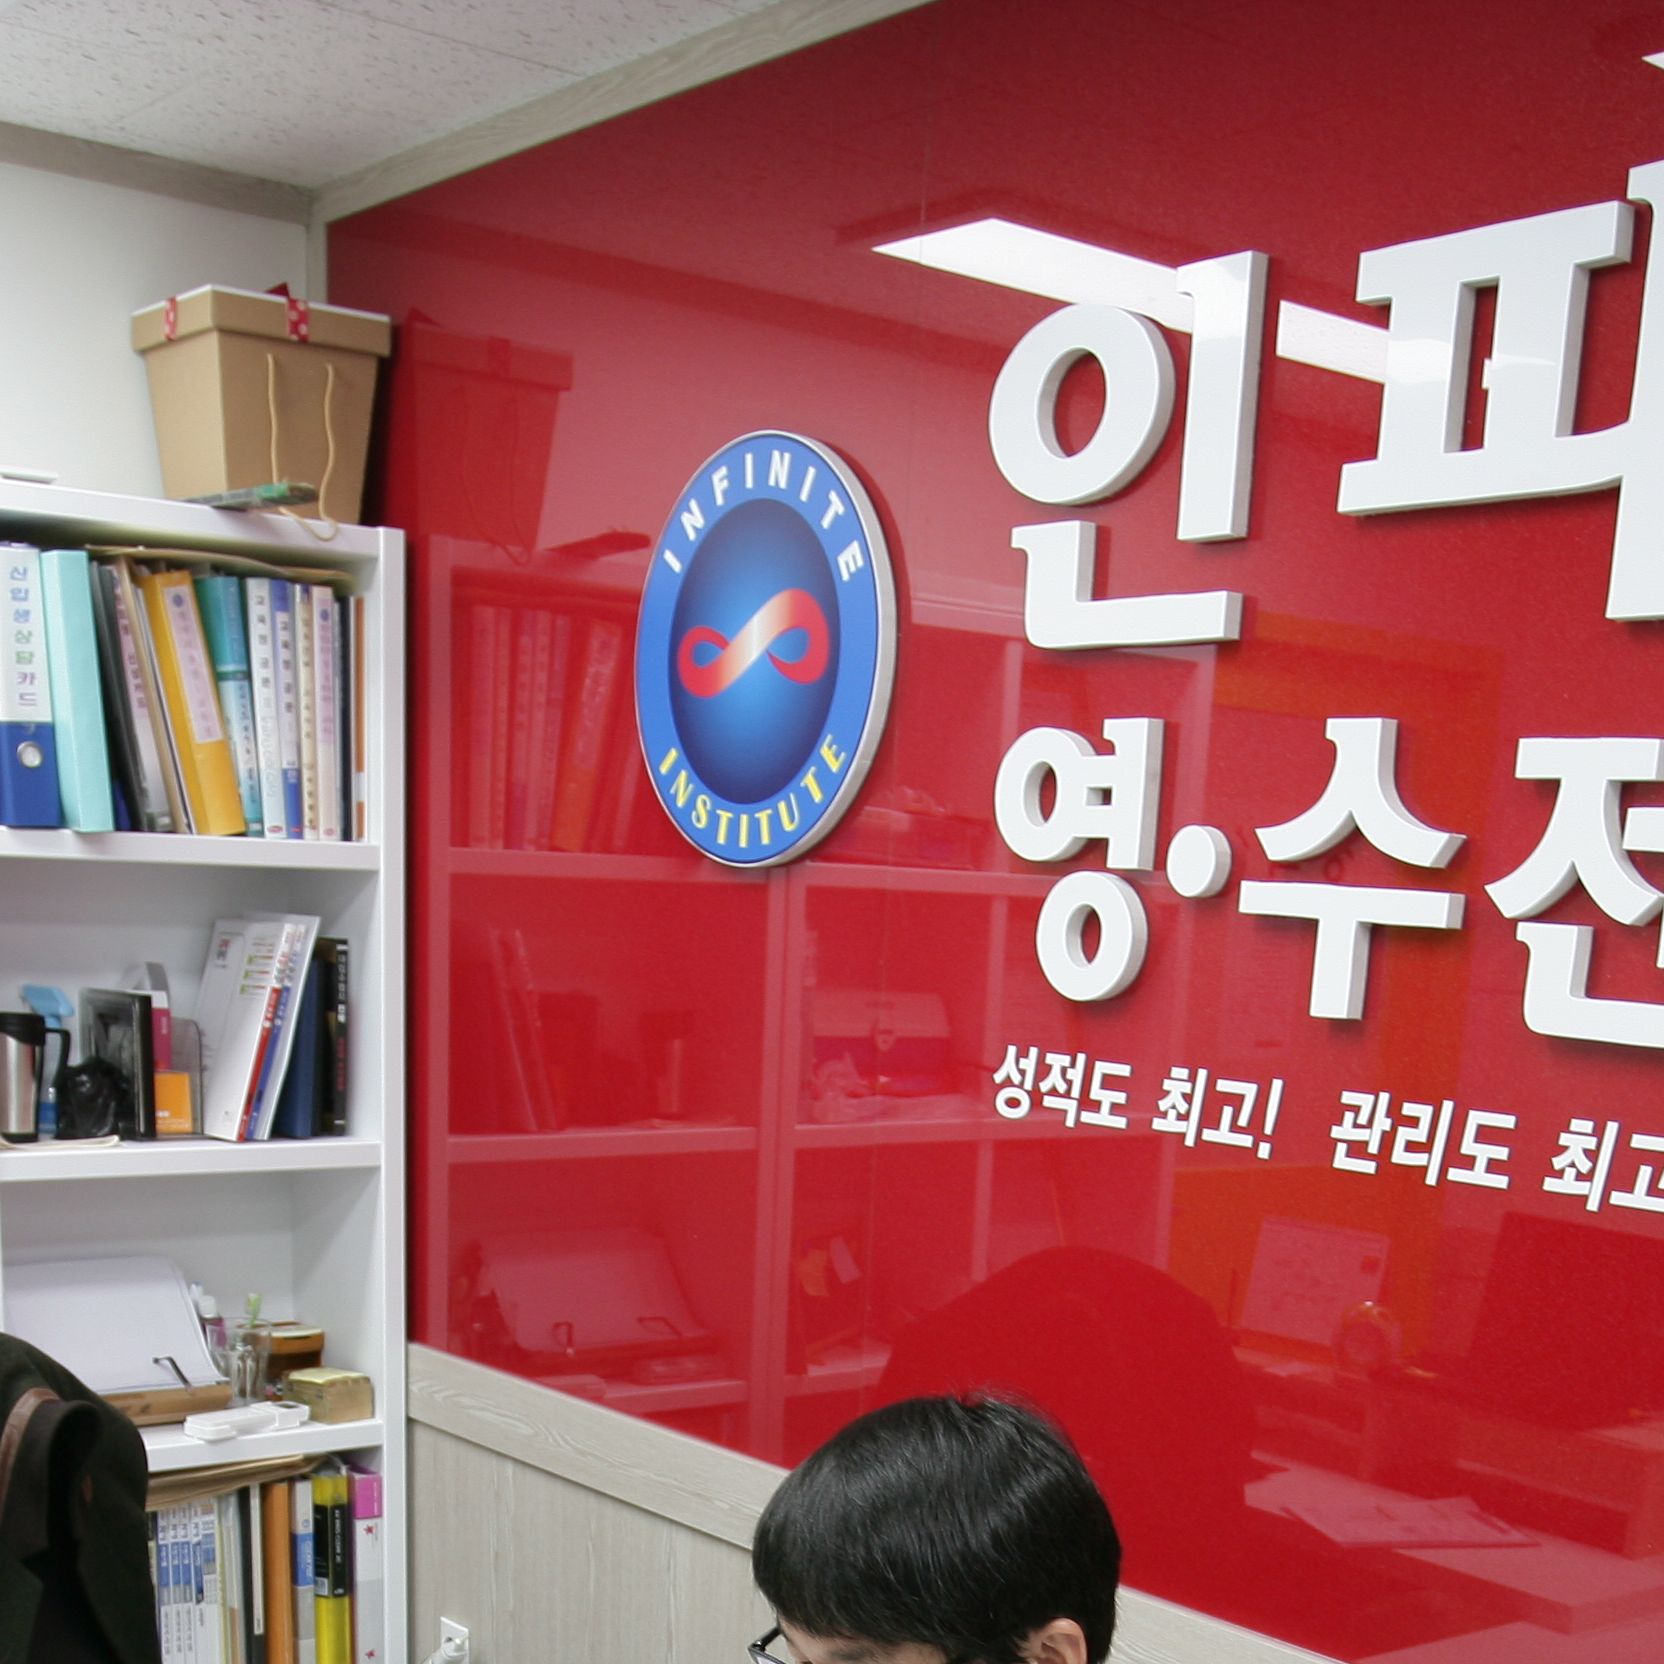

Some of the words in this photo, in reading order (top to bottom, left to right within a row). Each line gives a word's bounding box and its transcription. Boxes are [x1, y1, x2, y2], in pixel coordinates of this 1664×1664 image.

[663, 449, 864, 582] INFINITE
[659, 734, 846, 848] INSTITUTE
[993, 1044, 1132, 1129] 성적도
[1151, 1066, 1284, 1160] 최고!
[1329, 1090, 1517, 1189] 관리도
